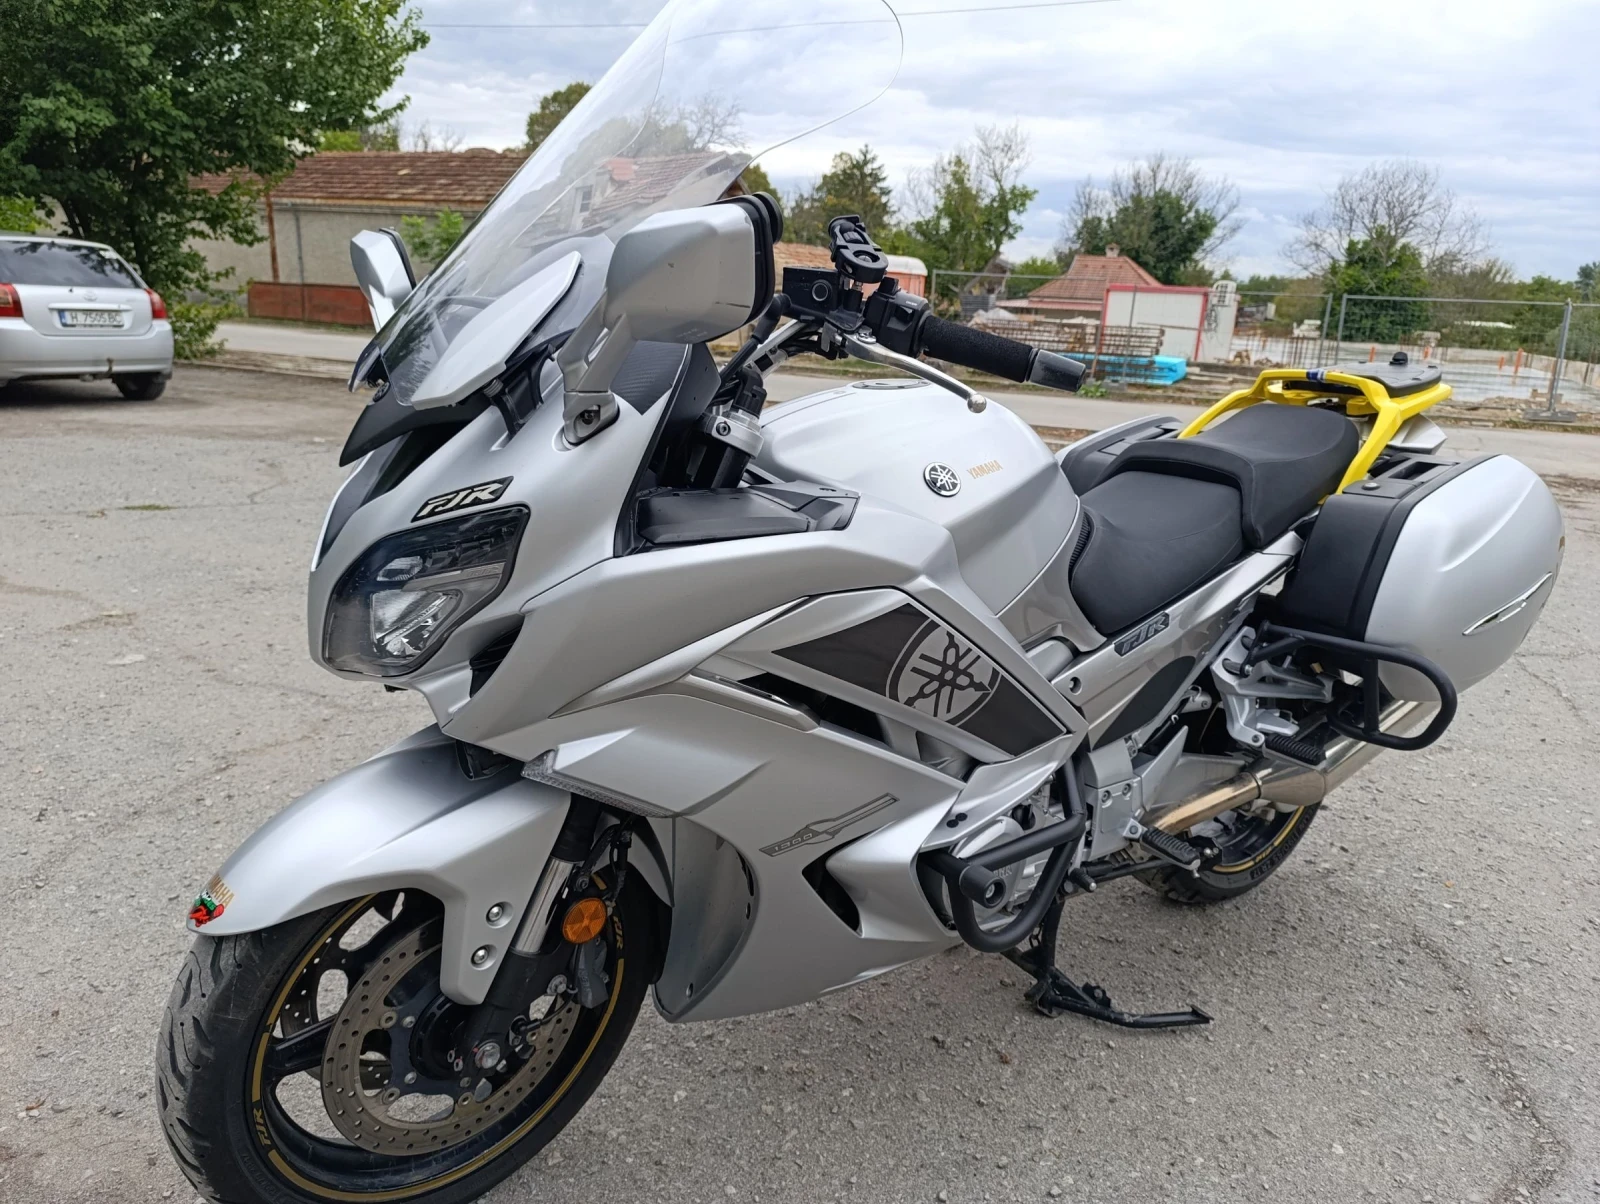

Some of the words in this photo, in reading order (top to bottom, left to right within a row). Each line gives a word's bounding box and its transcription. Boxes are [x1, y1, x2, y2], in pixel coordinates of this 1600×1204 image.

[966, 459, 1004, 480] YAMAHA
[415, 482, 504, 518] FJR
[1119, 614, 1167, 655] FJR
[773, 832, 814, 852] 1300
